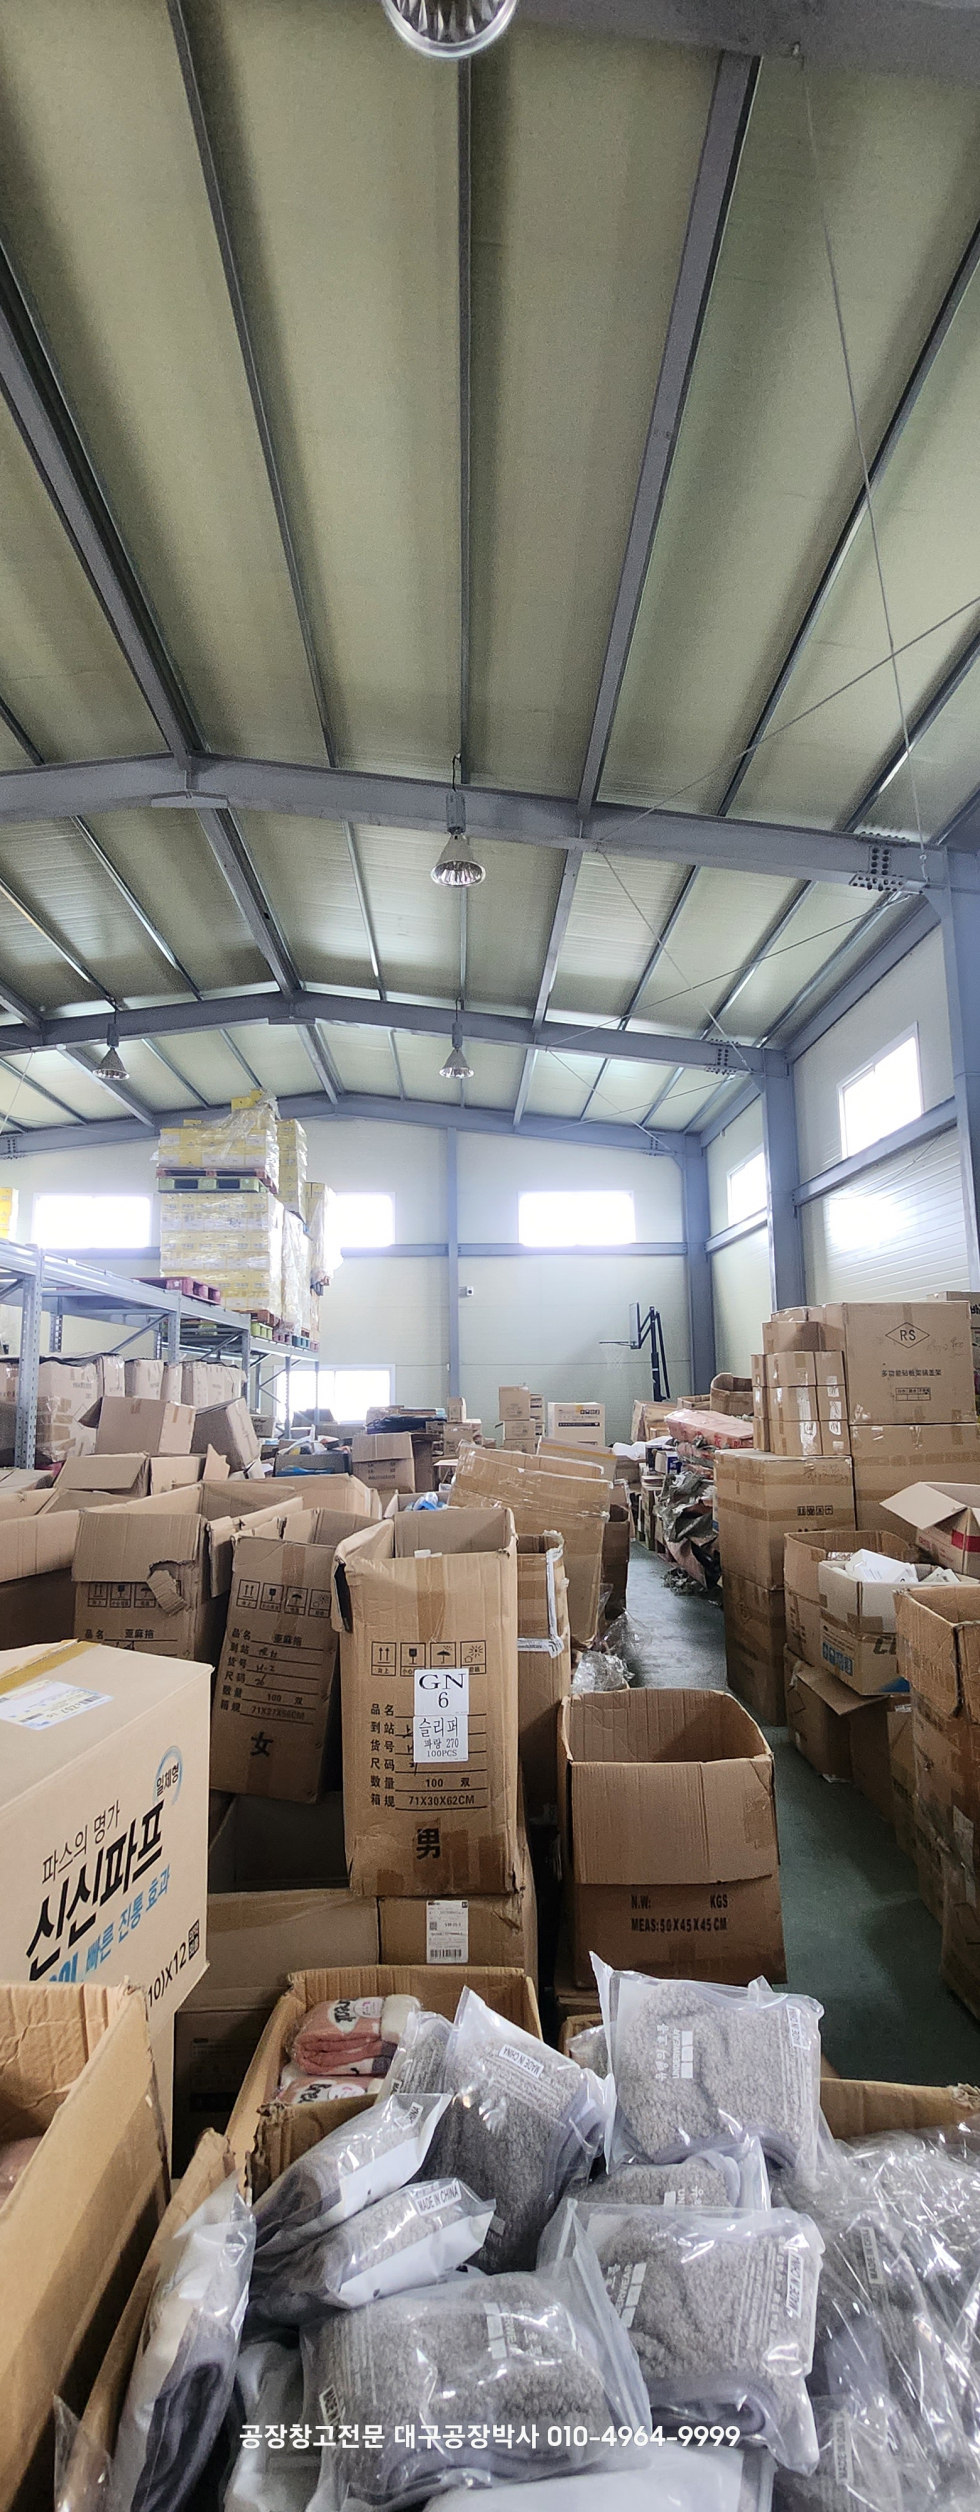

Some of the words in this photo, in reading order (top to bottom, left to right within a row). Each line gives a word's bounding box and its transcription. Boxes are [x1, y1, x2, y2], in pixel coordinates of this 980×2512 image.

[900, 1329, 916, 1341] RS
[419, 1673, 467, 1690] GN
[267, 1693, 282, 1702] 100
[438, 1691, 449, 1709] 6
[370, 1703, 395, 1717] 品名
[370, 1721, 395, 1736] 到站
[418, 1717, 459, 1738] 슬리퍼
[250, 1731, 274, 1758] 女
[370, 1739, 395, 1753] 货号
[446, 1738, 460, 1749] 270
[426, 1749, 458, 1758] 100PCS
[370, 1757, 395, 1771] 尺码
[156, 1762, 180, 1797] 일체형
[370, 1775, 395, 1790] 数量
[425, 1779, 444, 1788] 100
[460, 1777, 471, 1787] 双
[370, 1793, 396, 1808] 箱规
[408, 1795, 475, 1806] 71X30X62CM
[41, 1824, 89, 1885] 파스의
[93, 1799, 121, 1845] 명가
[416, 1827, 441, 1860] 男
[26, 1799, 165, 1982] 신신파프
[118, 1890, 144, 1943] 진통
[145, 1863, 171, 1914] 효과
[630, 1894, 652, 1910] N.W:
[709, 1893, 729, 1909] KGS
[503, 2046, 520, 2061] CHINA
[672, 2029, 681, 2079] UNDERWEAR
[524, 2061, 541, 2076] MADE
[419, 2193, 436, 2213] MADE
[434, 2190, 441, 2204] IN
[440, 2183, 460, 2201] CHINA
[866, 2256, 879, 2280] MADE
[787, 2284, 801, 2311] MADE
